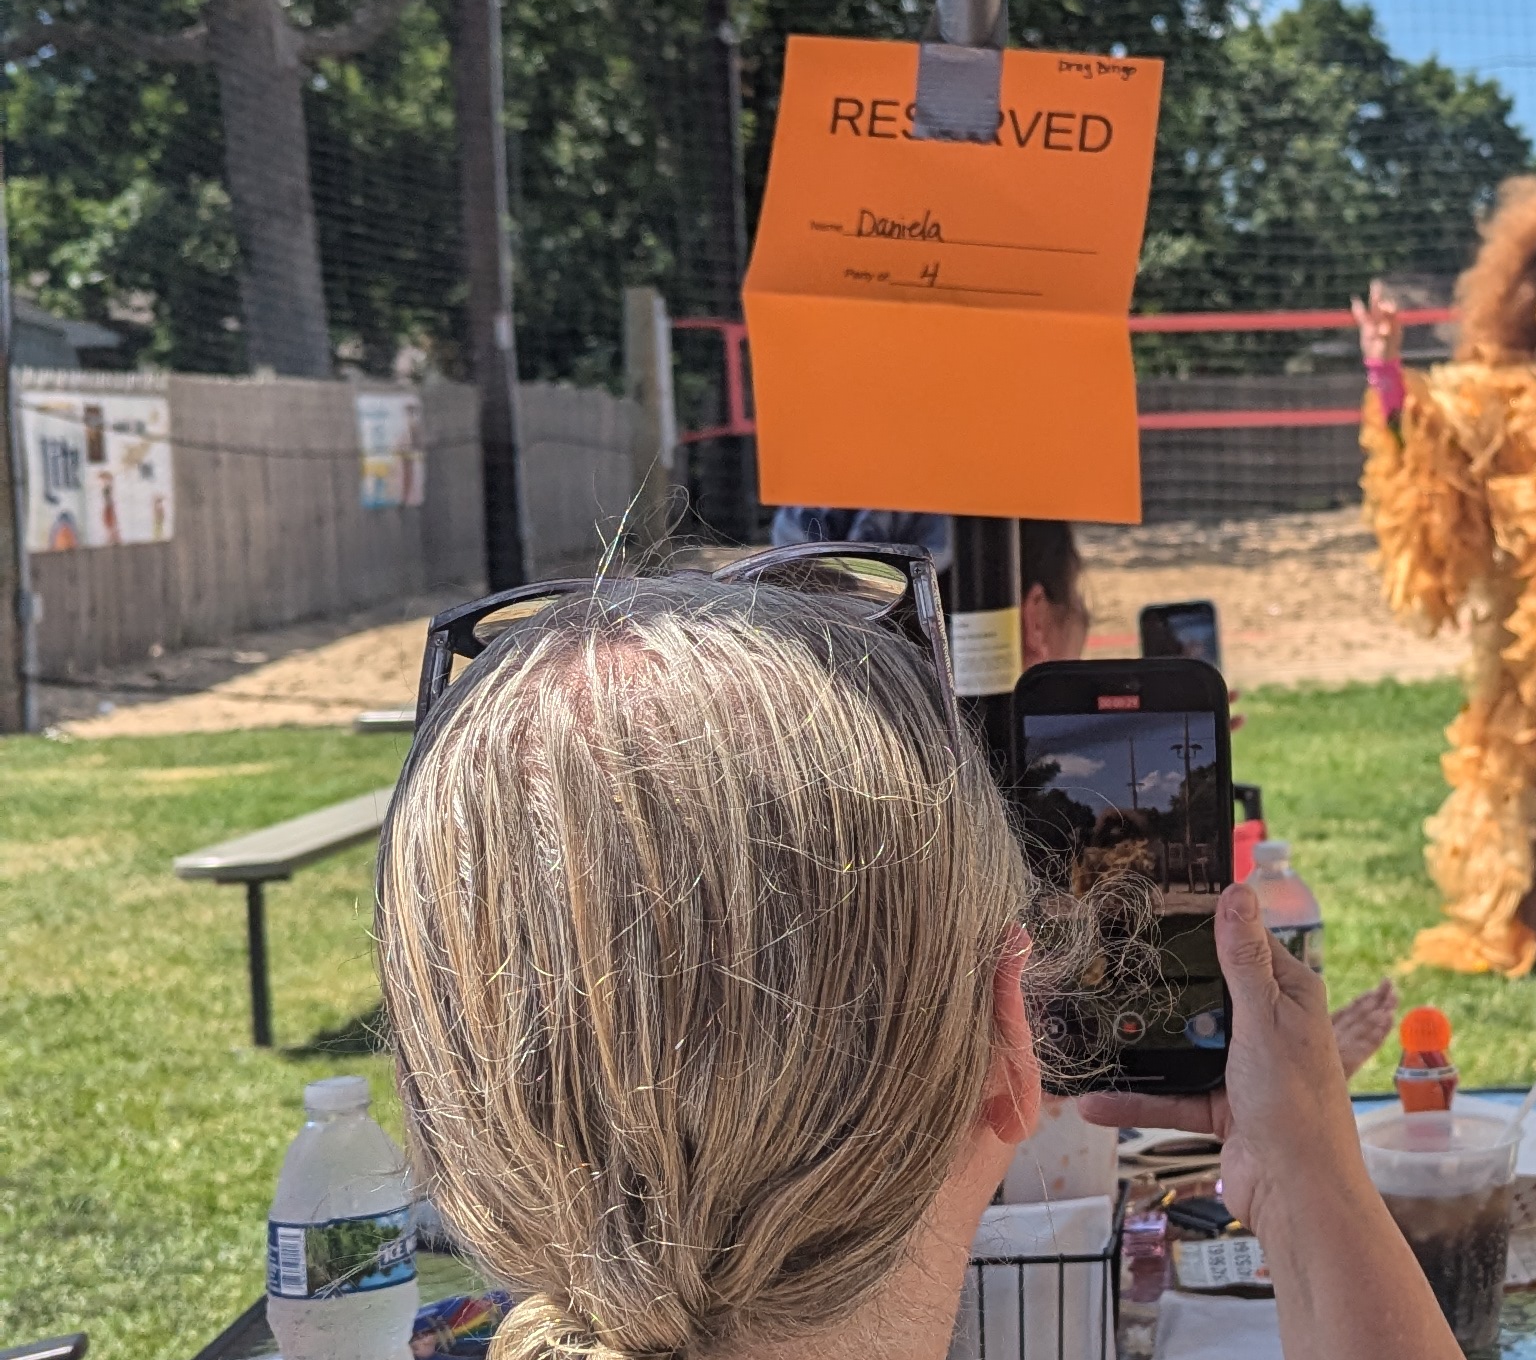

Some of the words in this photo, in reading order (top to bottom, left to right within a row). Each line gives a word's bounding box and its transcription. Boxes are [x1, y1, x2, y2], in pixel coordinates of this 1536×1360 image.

[830, 97, 1114, 154] REVED
[856, 209, 945, 243] Daniela
[920, 262, 940, 288] 4
